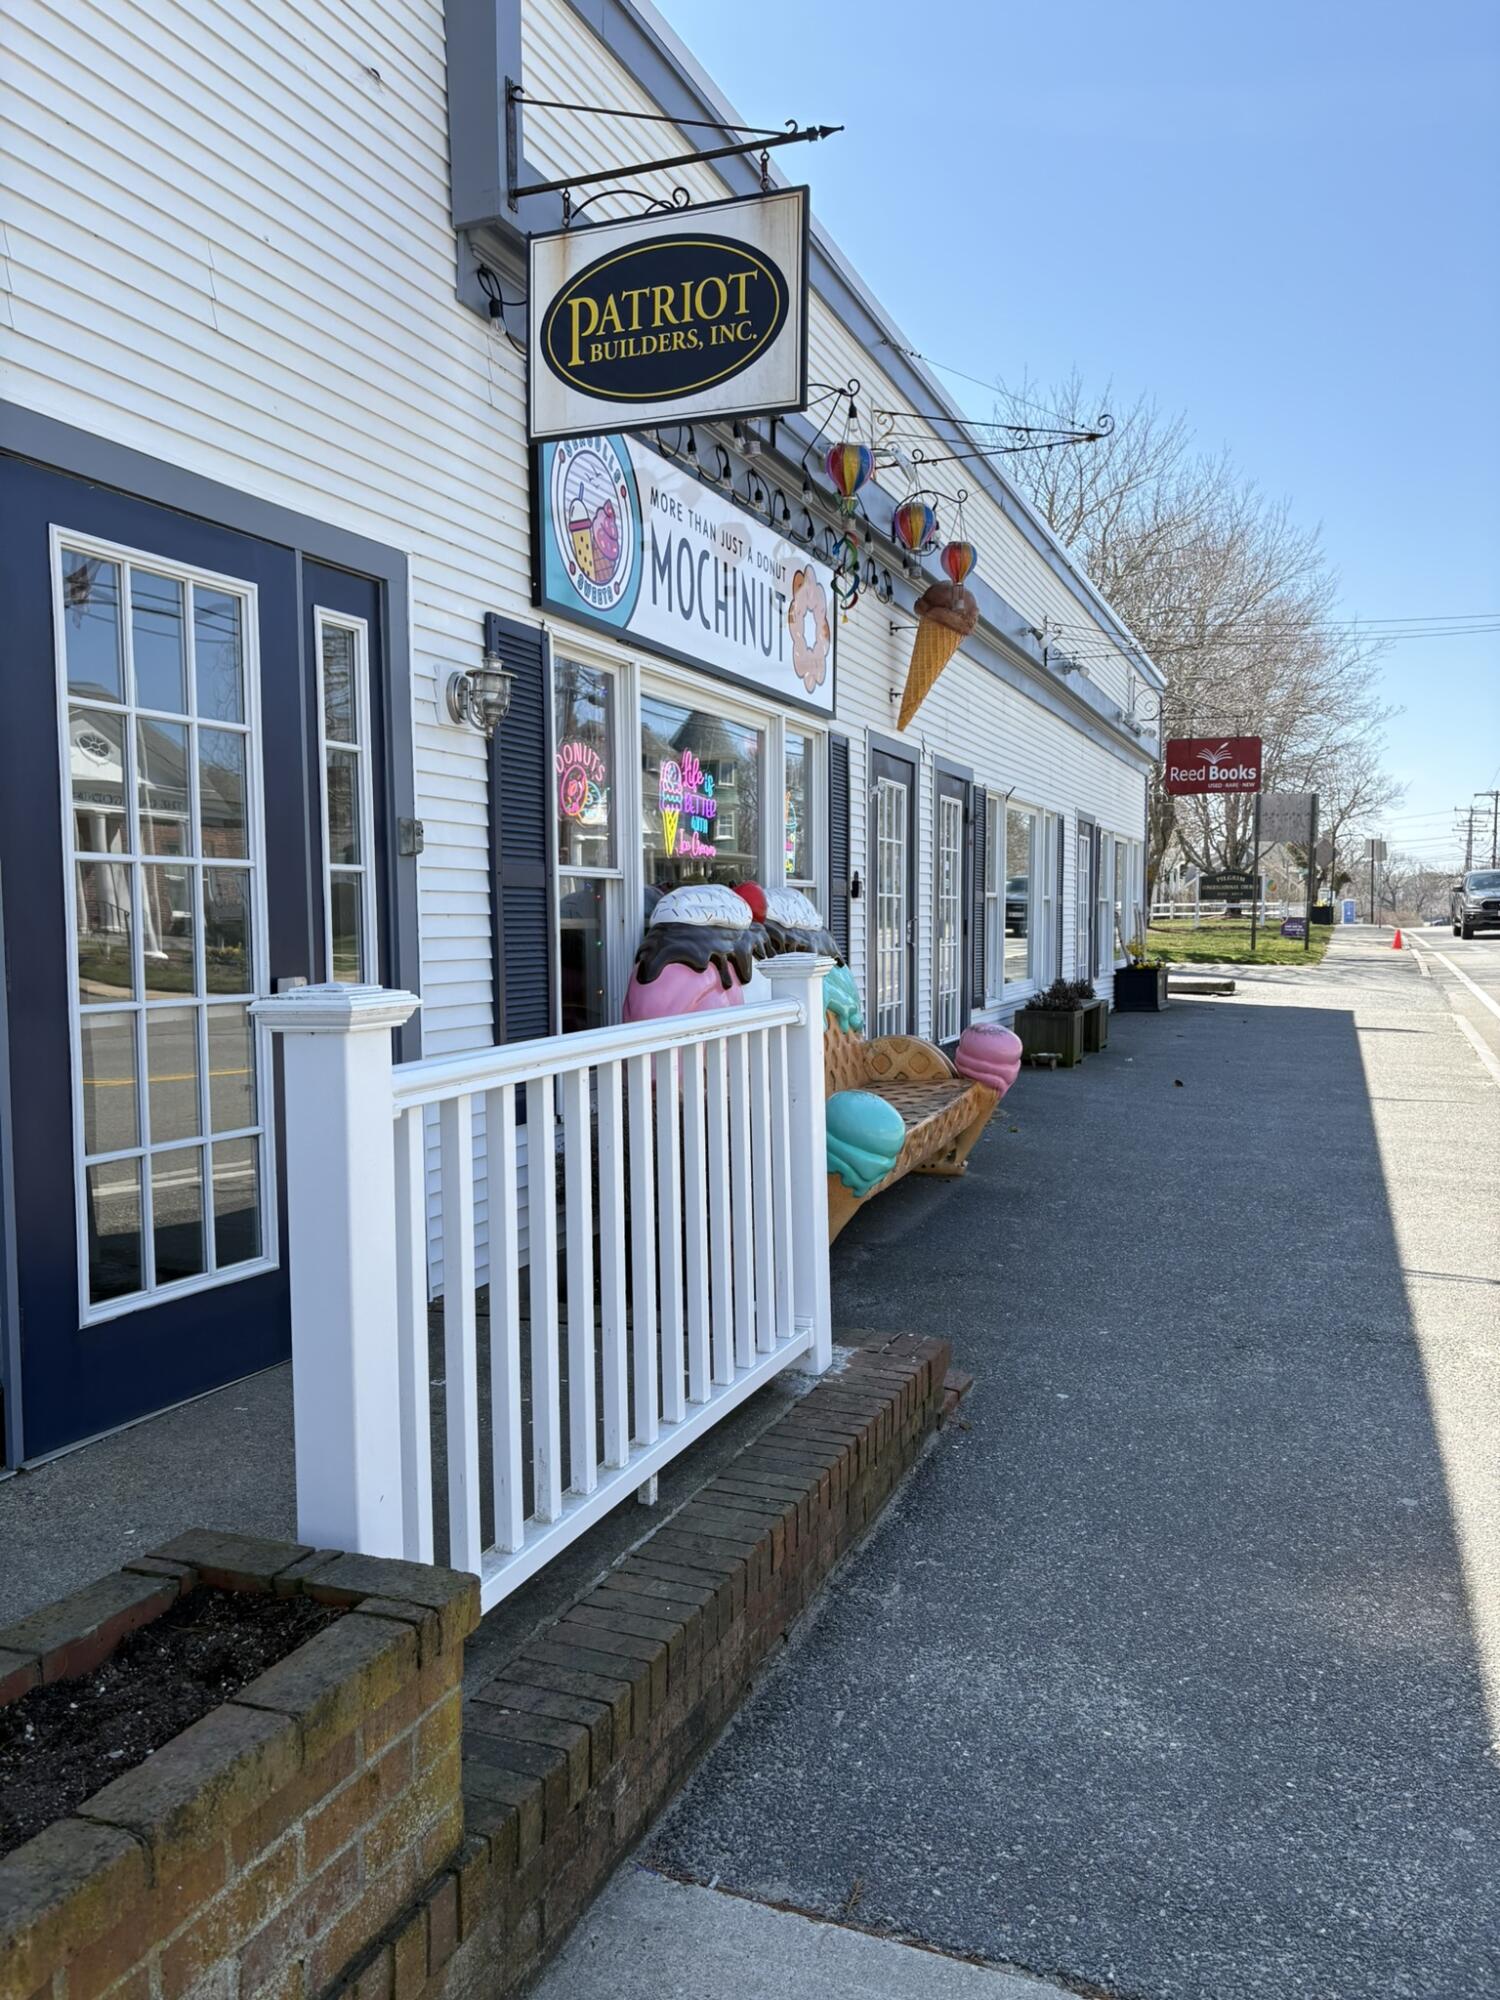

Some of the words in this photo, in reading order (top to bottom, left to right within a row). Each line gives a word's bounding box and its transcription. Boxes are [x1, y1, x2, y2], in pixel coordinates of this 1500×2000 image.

[567, 270, 758, 366] PATRIOT
[590, 329, 703, 363] BUILDERS,
[710, 320, 758, 346] INC.
[650, 486, 683, 522] MORE
[688, 509, 717, 540] THAN
[720, 530, 743, 555] JUST
[748, 546, 753, 564] A
[757, 551, 787, 583] DONUT
[577, 573, 613, 605] SWEETS
[650, 521, 786, 662] MOCHINUT
[556, 742, 605, 781] DONUTS
[1170, 765, 1206, 782] Reed
[1209, 765, 1257, 780] Books
